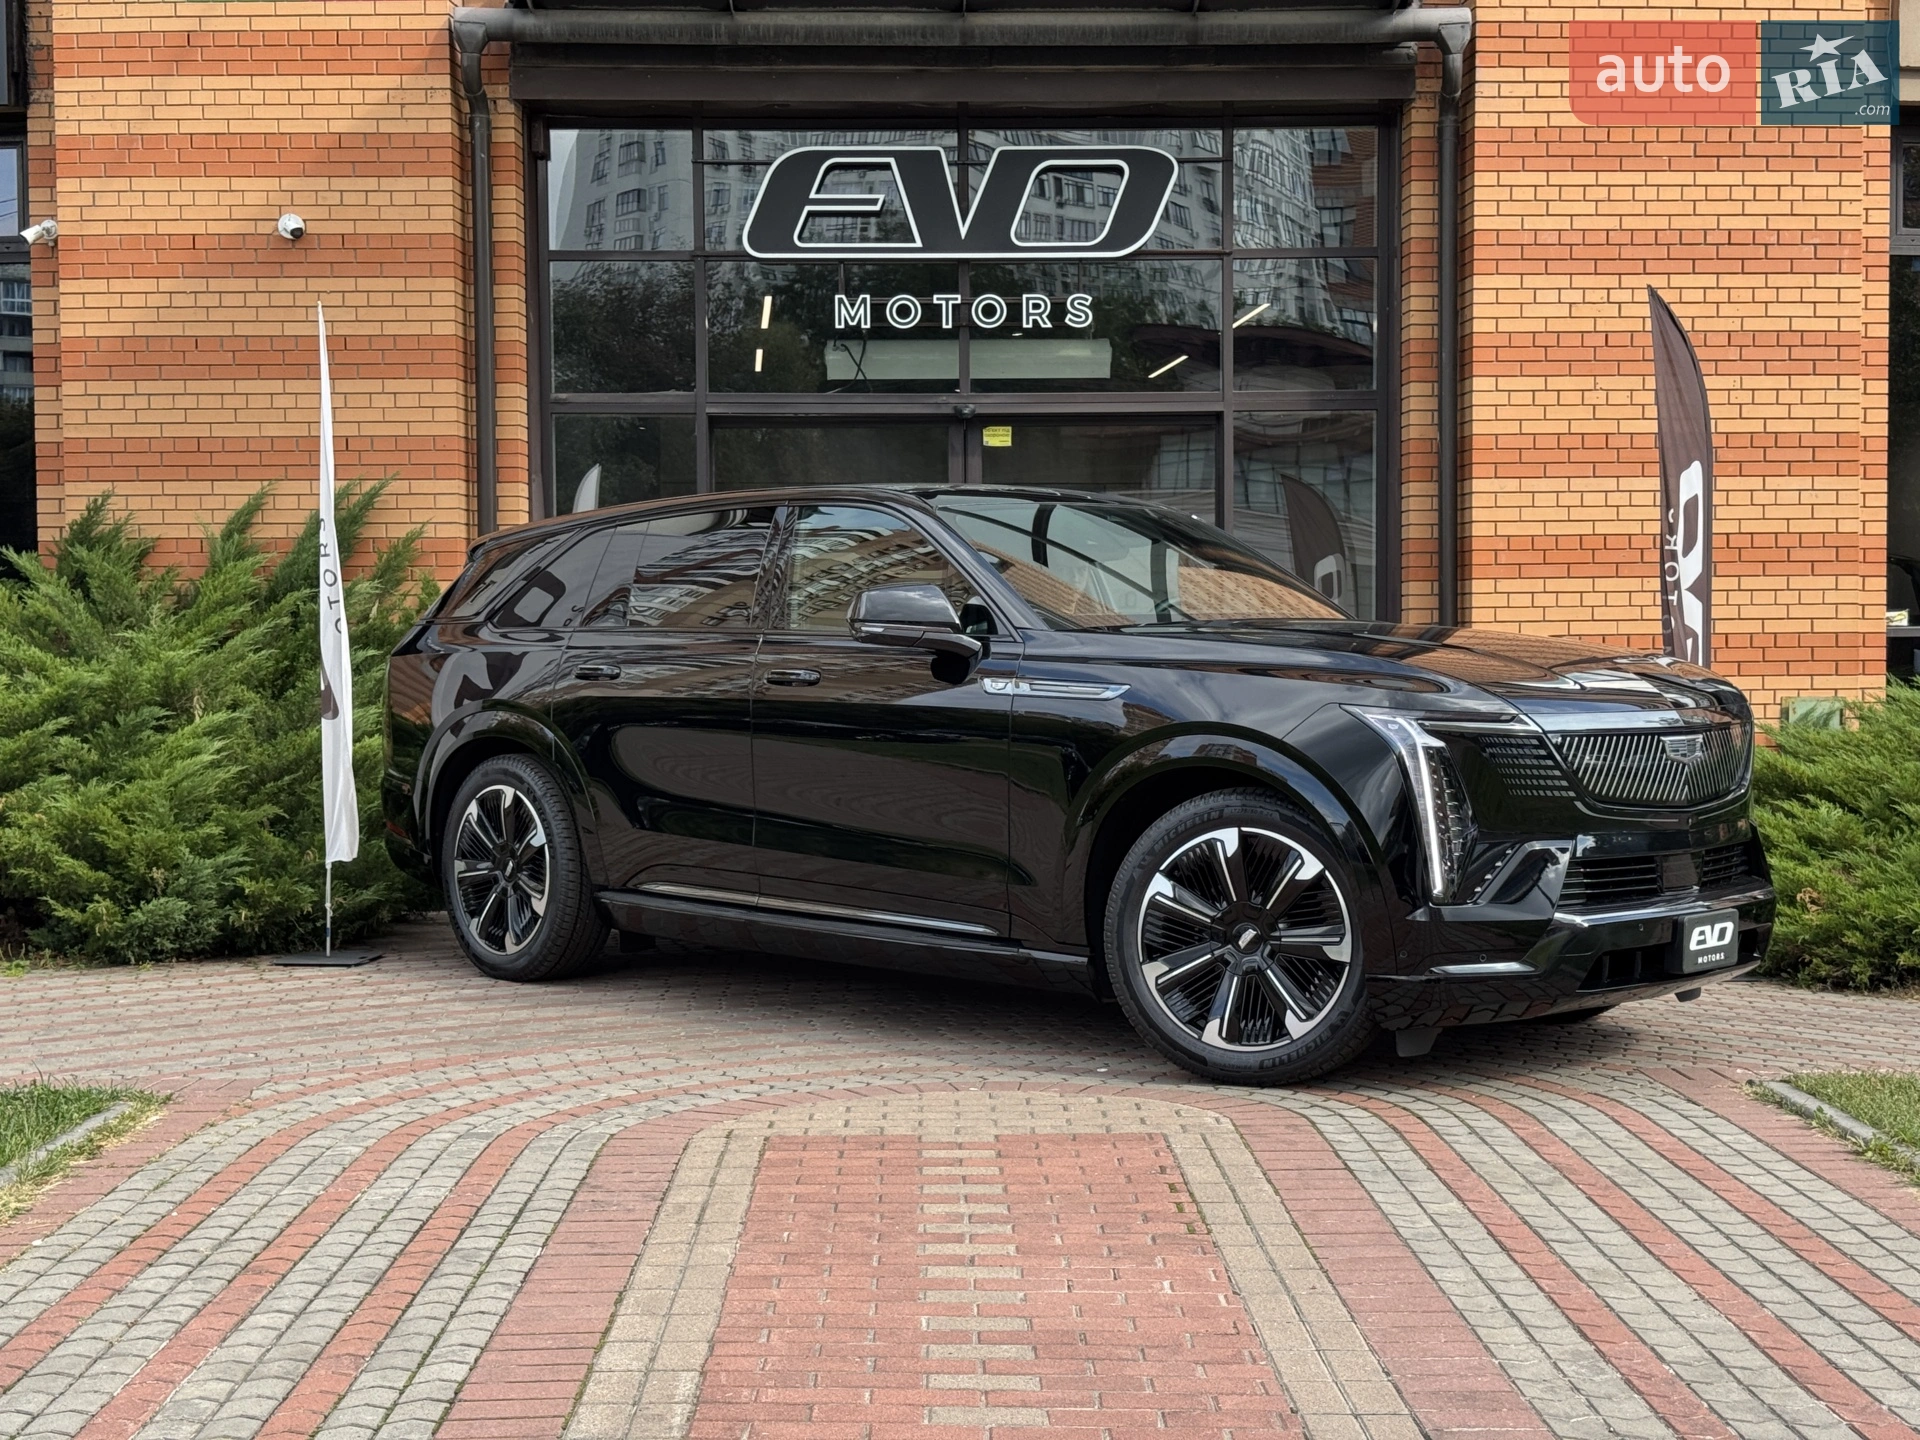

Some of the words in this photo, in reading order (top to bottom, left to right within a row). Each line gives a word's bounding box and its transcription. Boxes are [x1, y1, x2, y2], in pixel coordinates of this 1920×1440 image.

[742, 145, 1180, 259] EVO
[834, 293, 1094, 329] MOTORS
[1154, 809, 1221, 854] MICHELIN
[1689, 921, 1735, 951] EVO
[1697, 952, 1725, 964] MOTORS
[1263, 1029, 1333, 1069] MICHELIN
